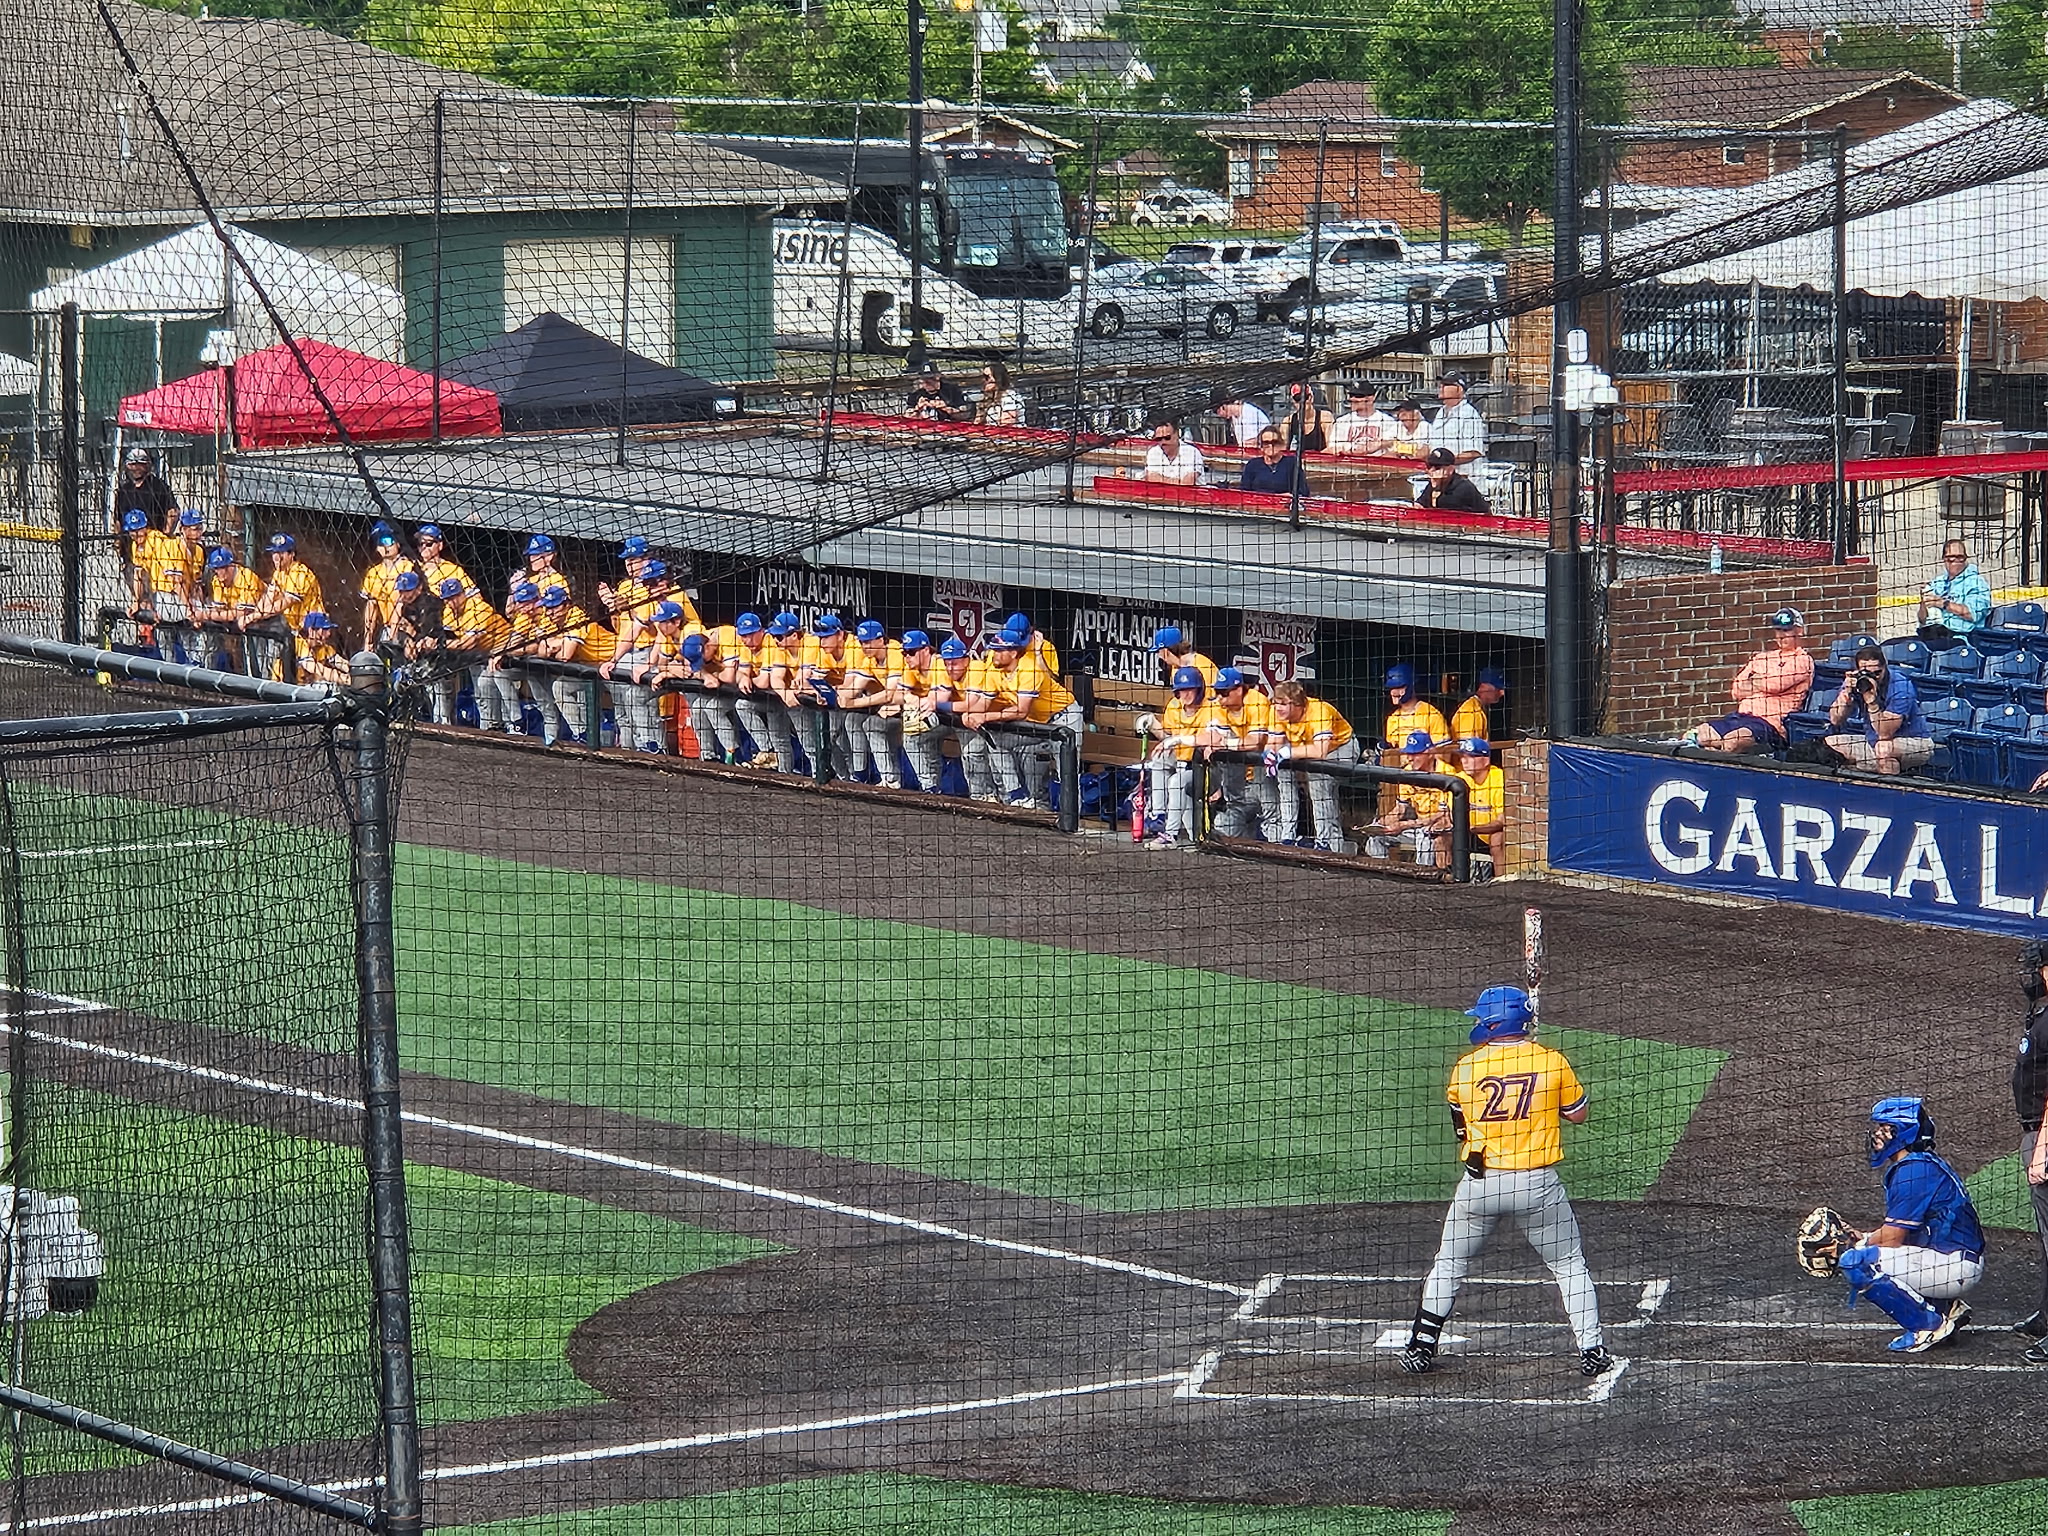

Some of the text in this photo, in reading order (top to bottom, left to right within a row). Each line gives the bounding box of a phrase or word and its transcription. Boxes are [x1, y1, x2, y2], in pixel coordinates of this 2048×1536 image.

[756, 567, 867, 617] APPALACHIAN
[935, 579, 999, 601] BALLPARK
[1072, 608, 1195, 651] APPALACN
[1245, 619, 1316, 644] BALLPARK
[1099, 646, 1165, 686] LEAGUE
[1645, 779, 2048, 920] GARZA L
[1476, 1072, 1539, 1122] 27
